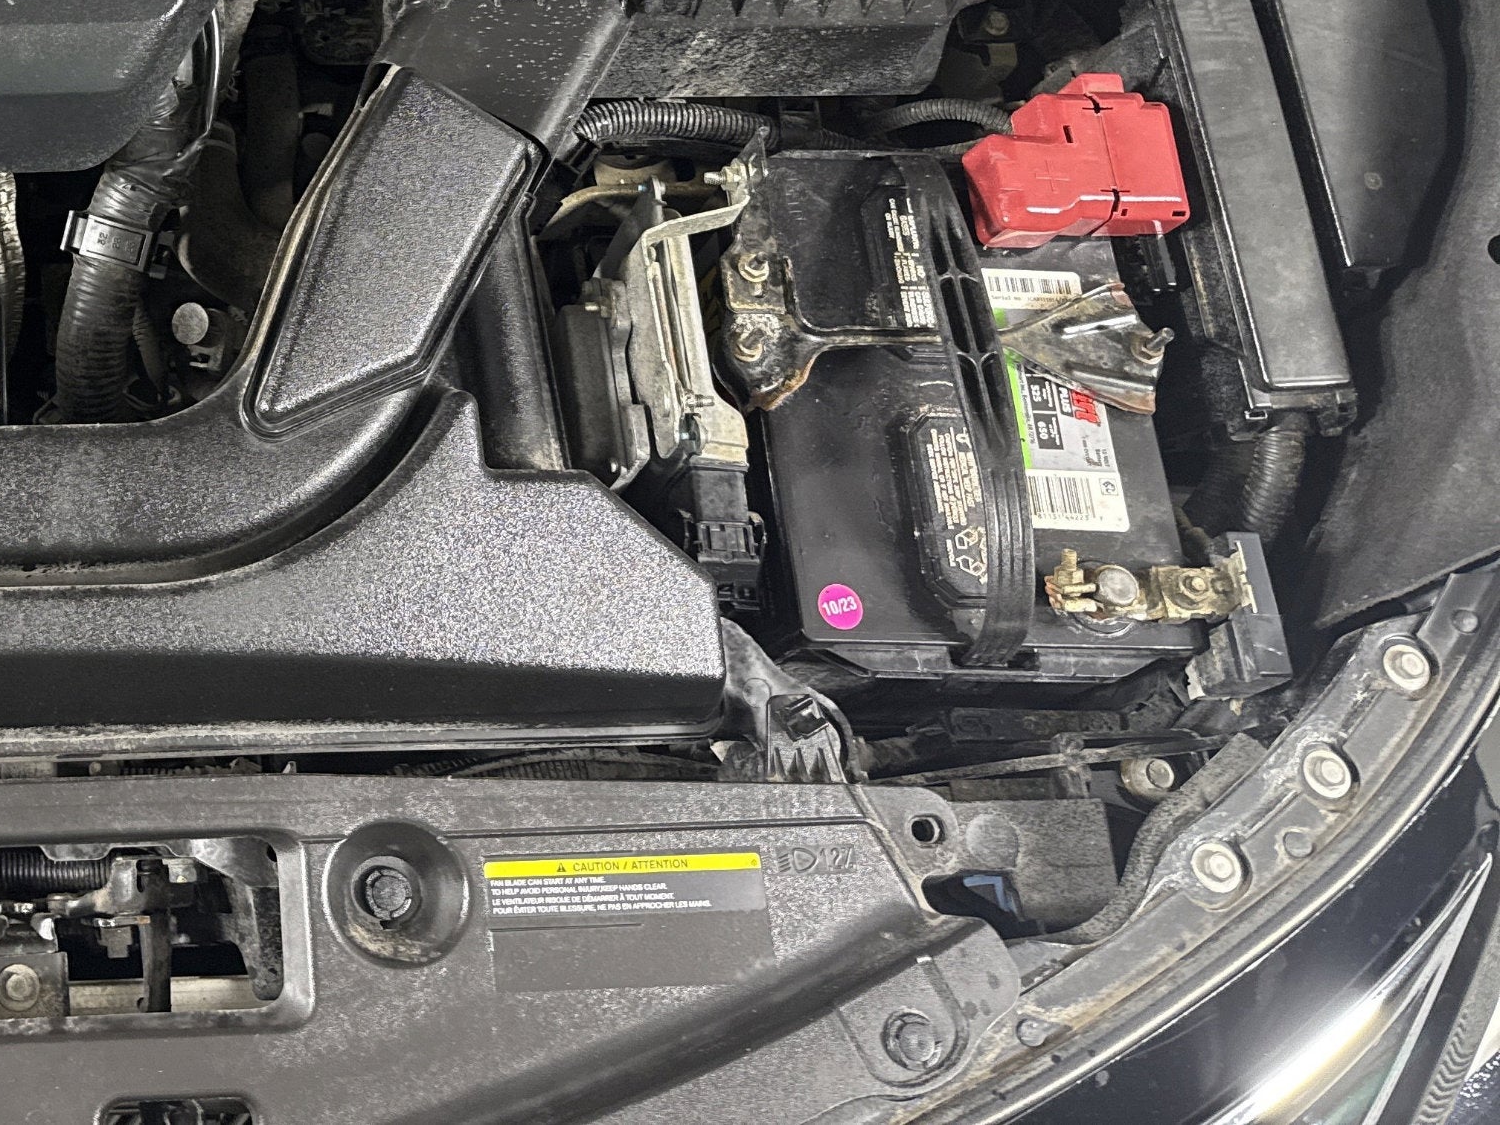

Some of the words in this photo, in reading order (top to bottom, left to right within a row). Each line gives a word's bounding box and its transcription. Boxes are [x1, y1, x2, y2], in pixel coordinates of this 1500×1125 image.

[1030, 383, 1041, 402] 525
[1058, 386, 1071, 413] PLUS
[1037, 420, 1048, 440] 650
[822, 596, 858, 615] 10/23
[573, 862, 619, 872] CAUTION
[632, 860, 688, 869] ATTENTION
[619, 883, 643, 891] HANDS
[502, 897, 544, 905] VENTILATEUR
[620, 893, 625, 901] À
[514, 906, 536, 914] ÉVITER
[633, 901, 674, 909] APPROCHER
